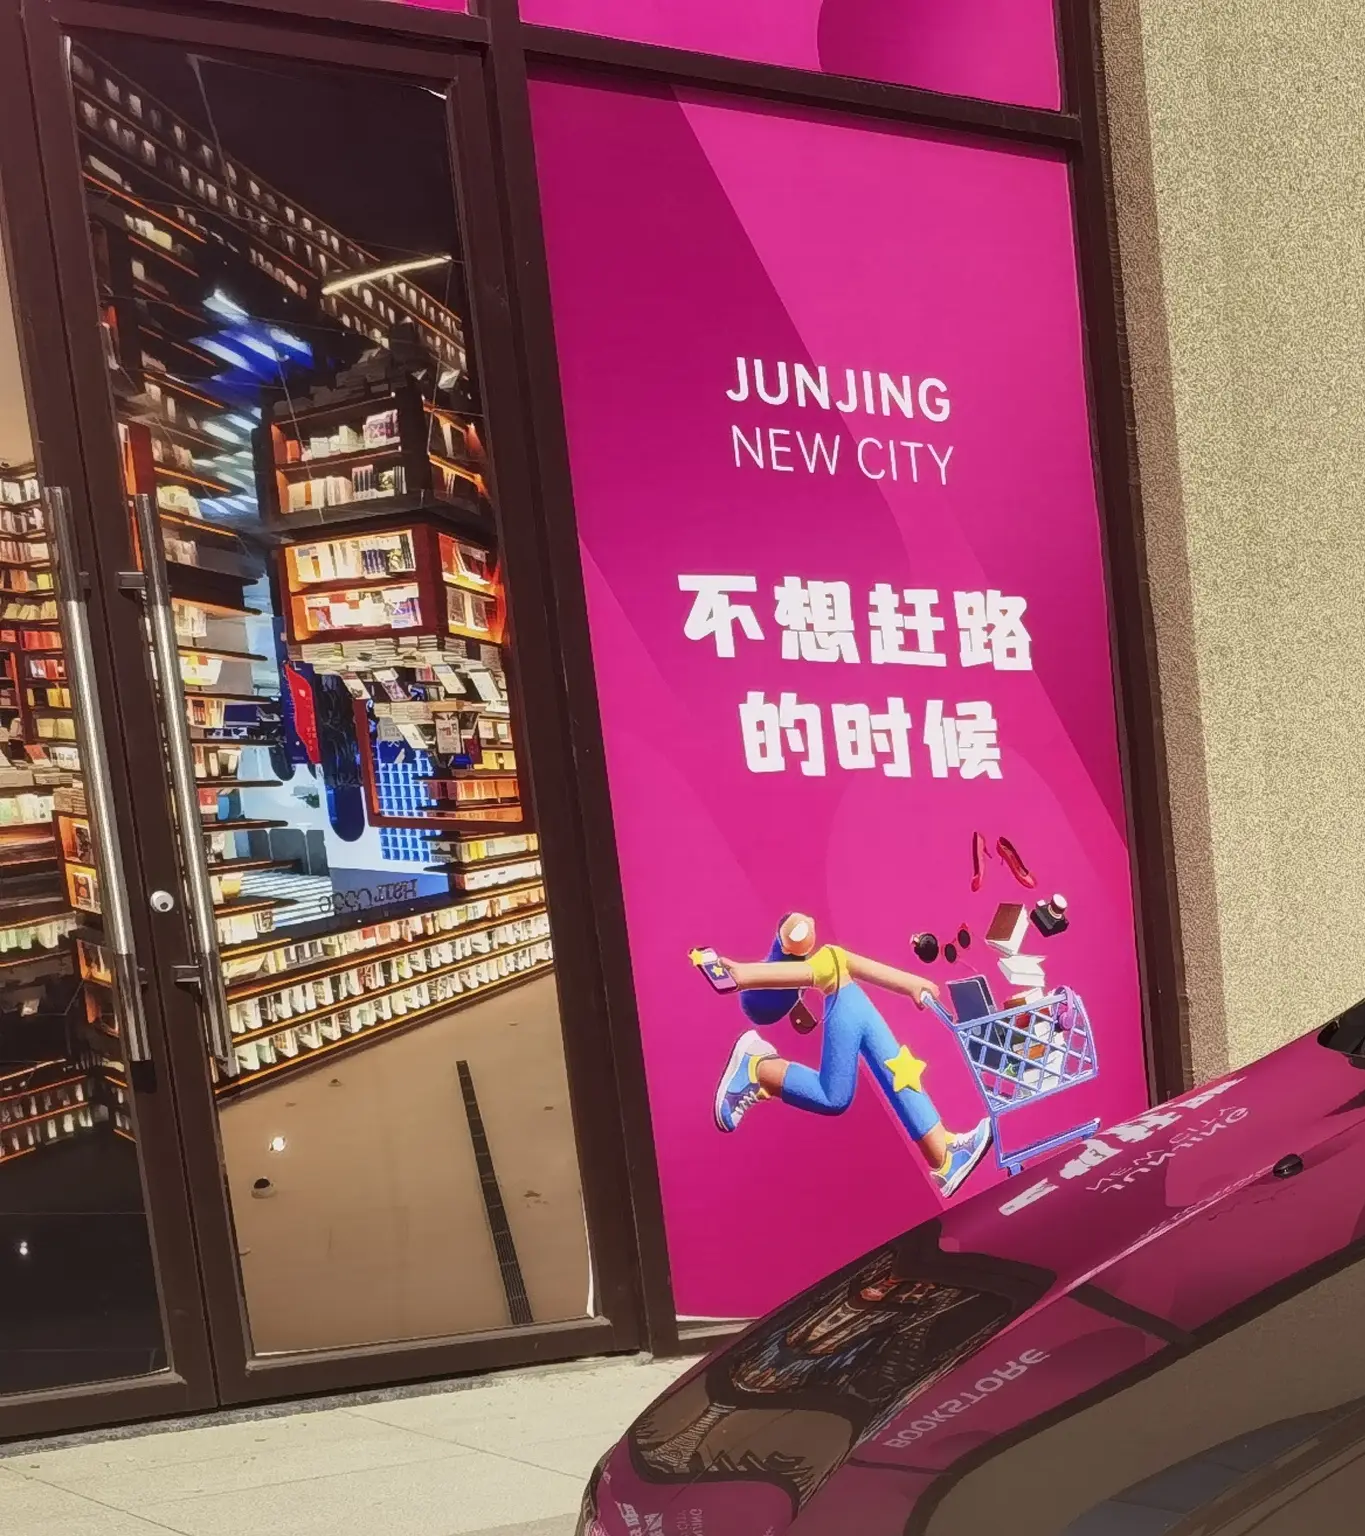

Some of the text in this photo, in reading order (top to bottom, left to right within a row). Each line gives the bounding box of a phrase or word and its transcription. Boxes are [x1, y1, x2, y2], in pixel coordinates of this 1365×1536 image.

[726, 356, 951, 423] JUNJING
[731, 425, 955, 486] NEW CITY
[677, 574, 1033, 671] 不想赶路
[738, 691, 1003, 780] 的时候
